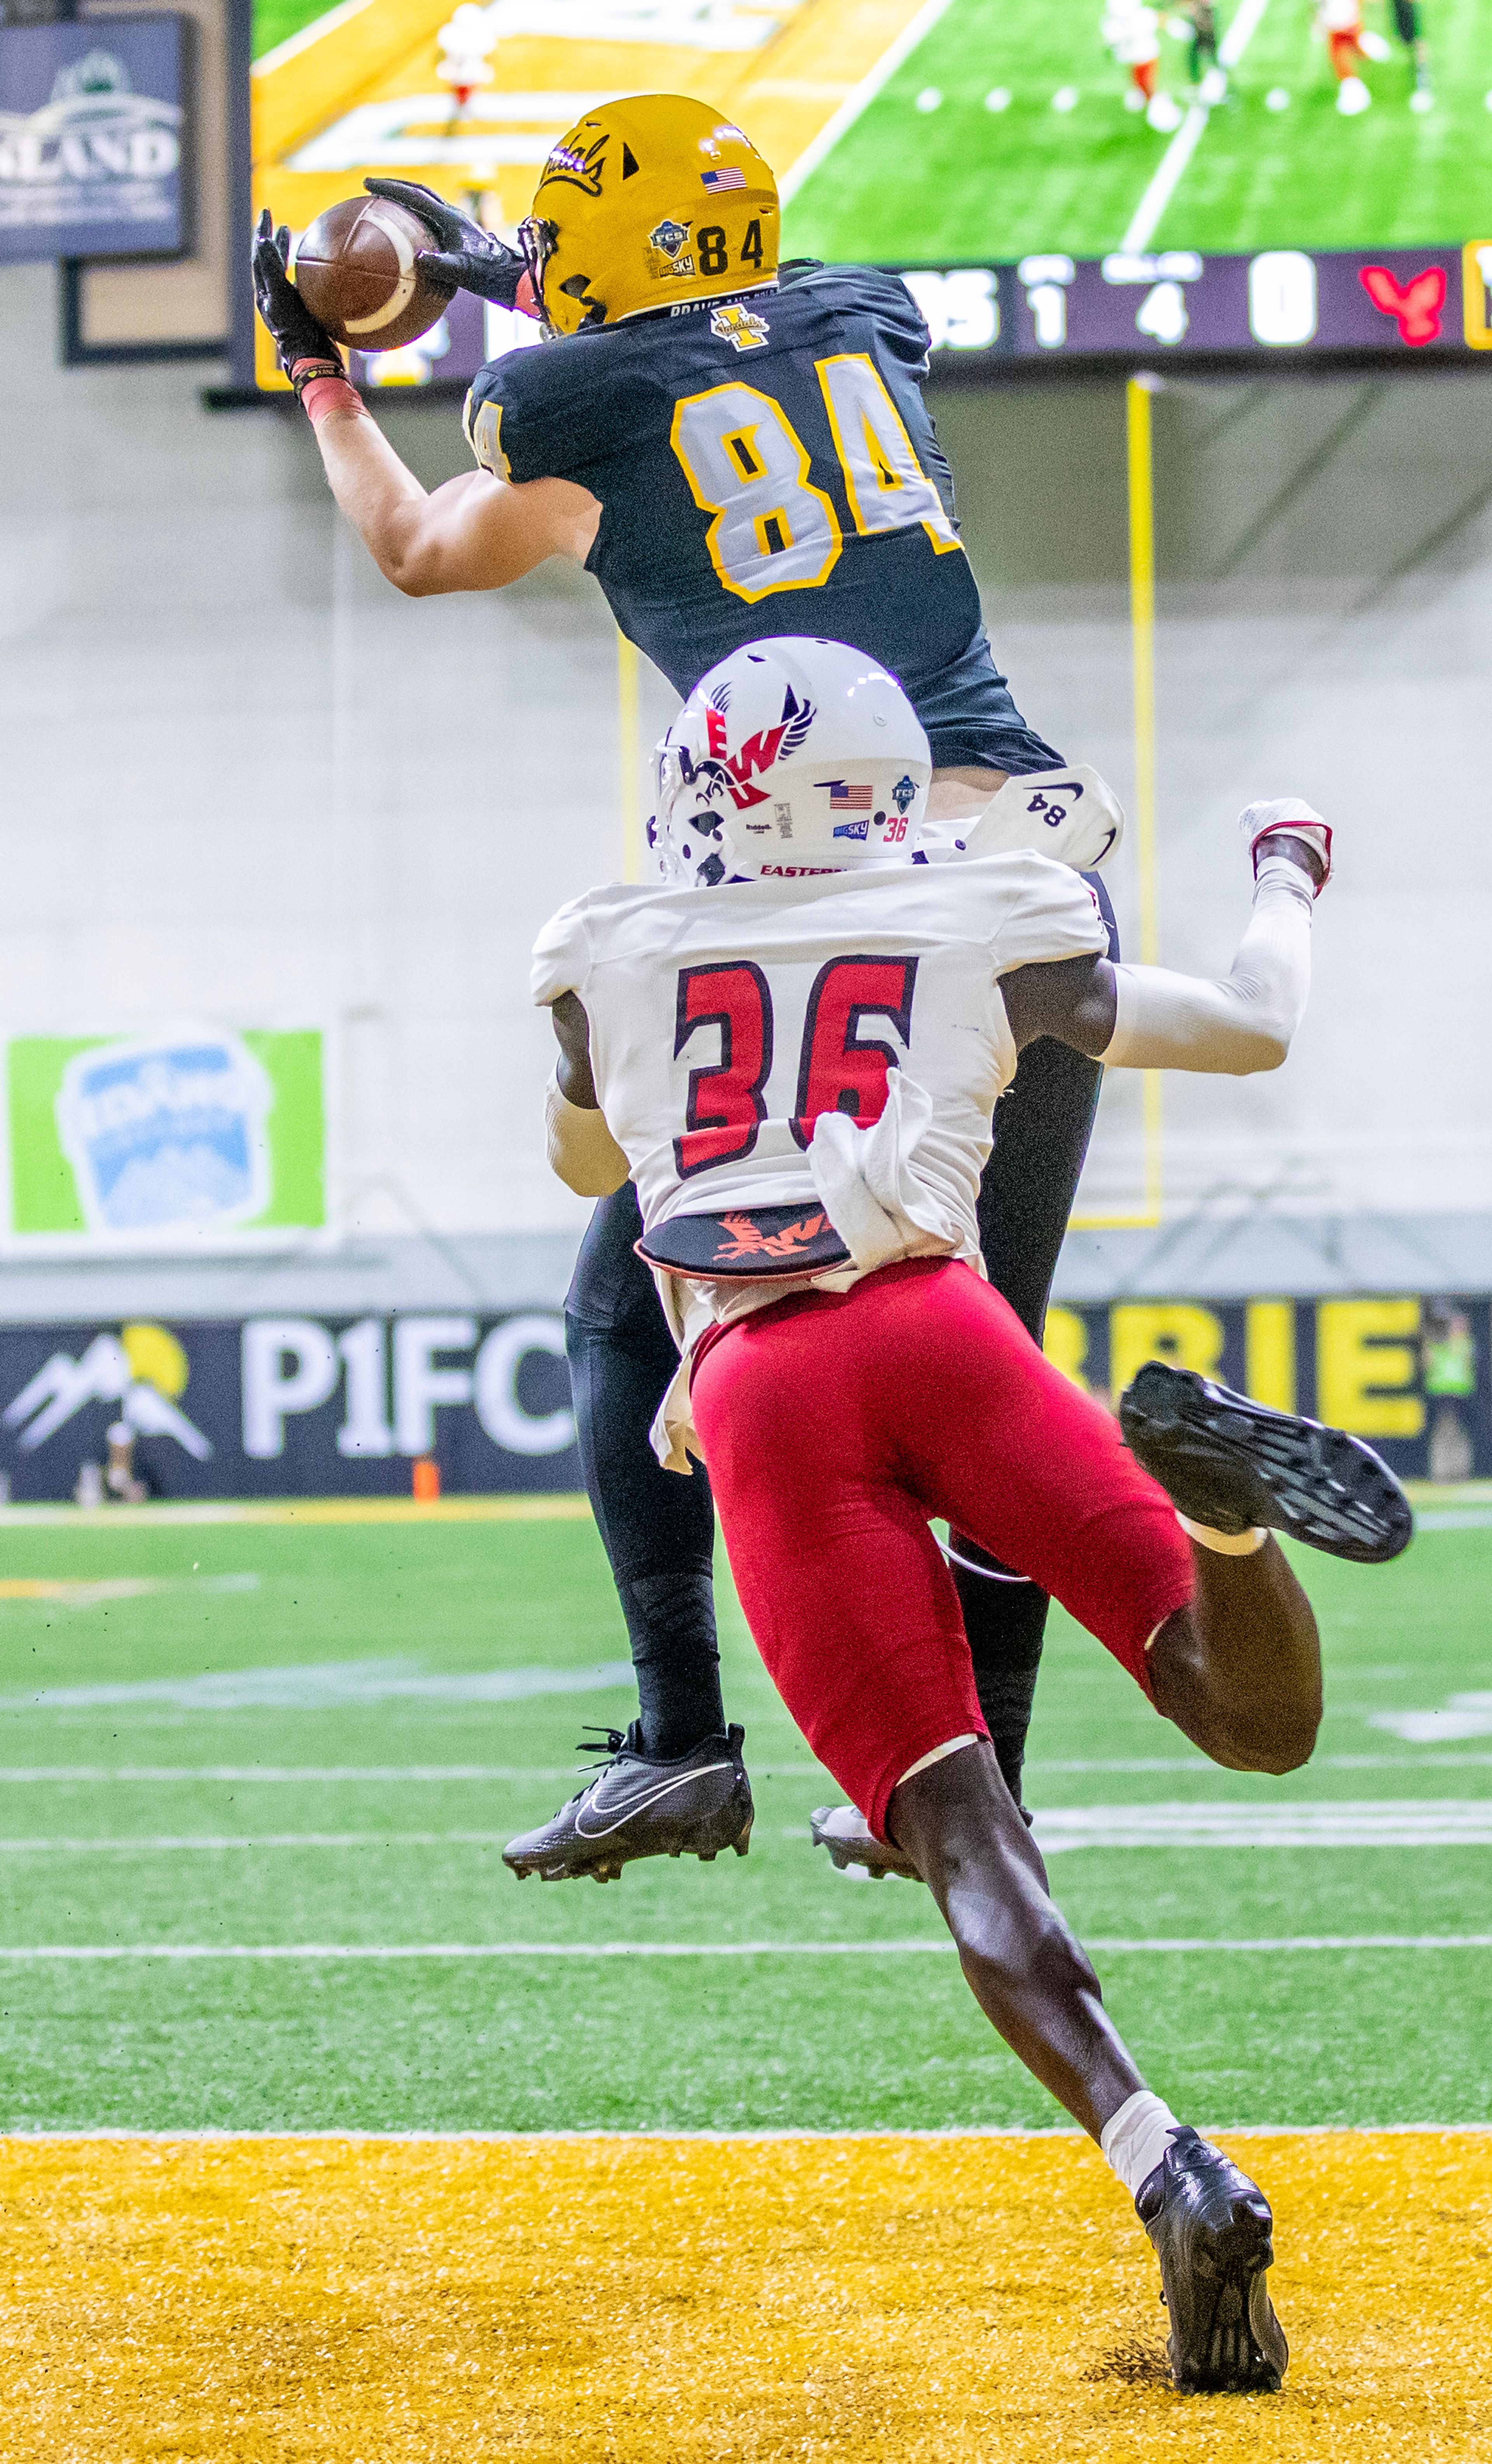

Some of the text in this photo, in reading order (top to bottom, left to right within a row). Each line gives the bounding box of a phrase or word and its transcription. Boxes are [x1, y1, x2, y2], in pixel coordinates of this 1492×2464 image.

[0, 134, 180, 180] LAND
[697, 218, 763, 276] 84
[1027, 284, 1067, 349] 1
[1135, 281, 1190, 346] 4
[1249, 250, 1317, 347] 0
[462, 388, 512, 487] 4
[671, 353, 965, 604] 84
[883, 818, 909, 842] 36
[1027, 793, 1067, 827] 84
[760, 865, 847, 877] EASTER
[674, 954, 919, 1181] 36
